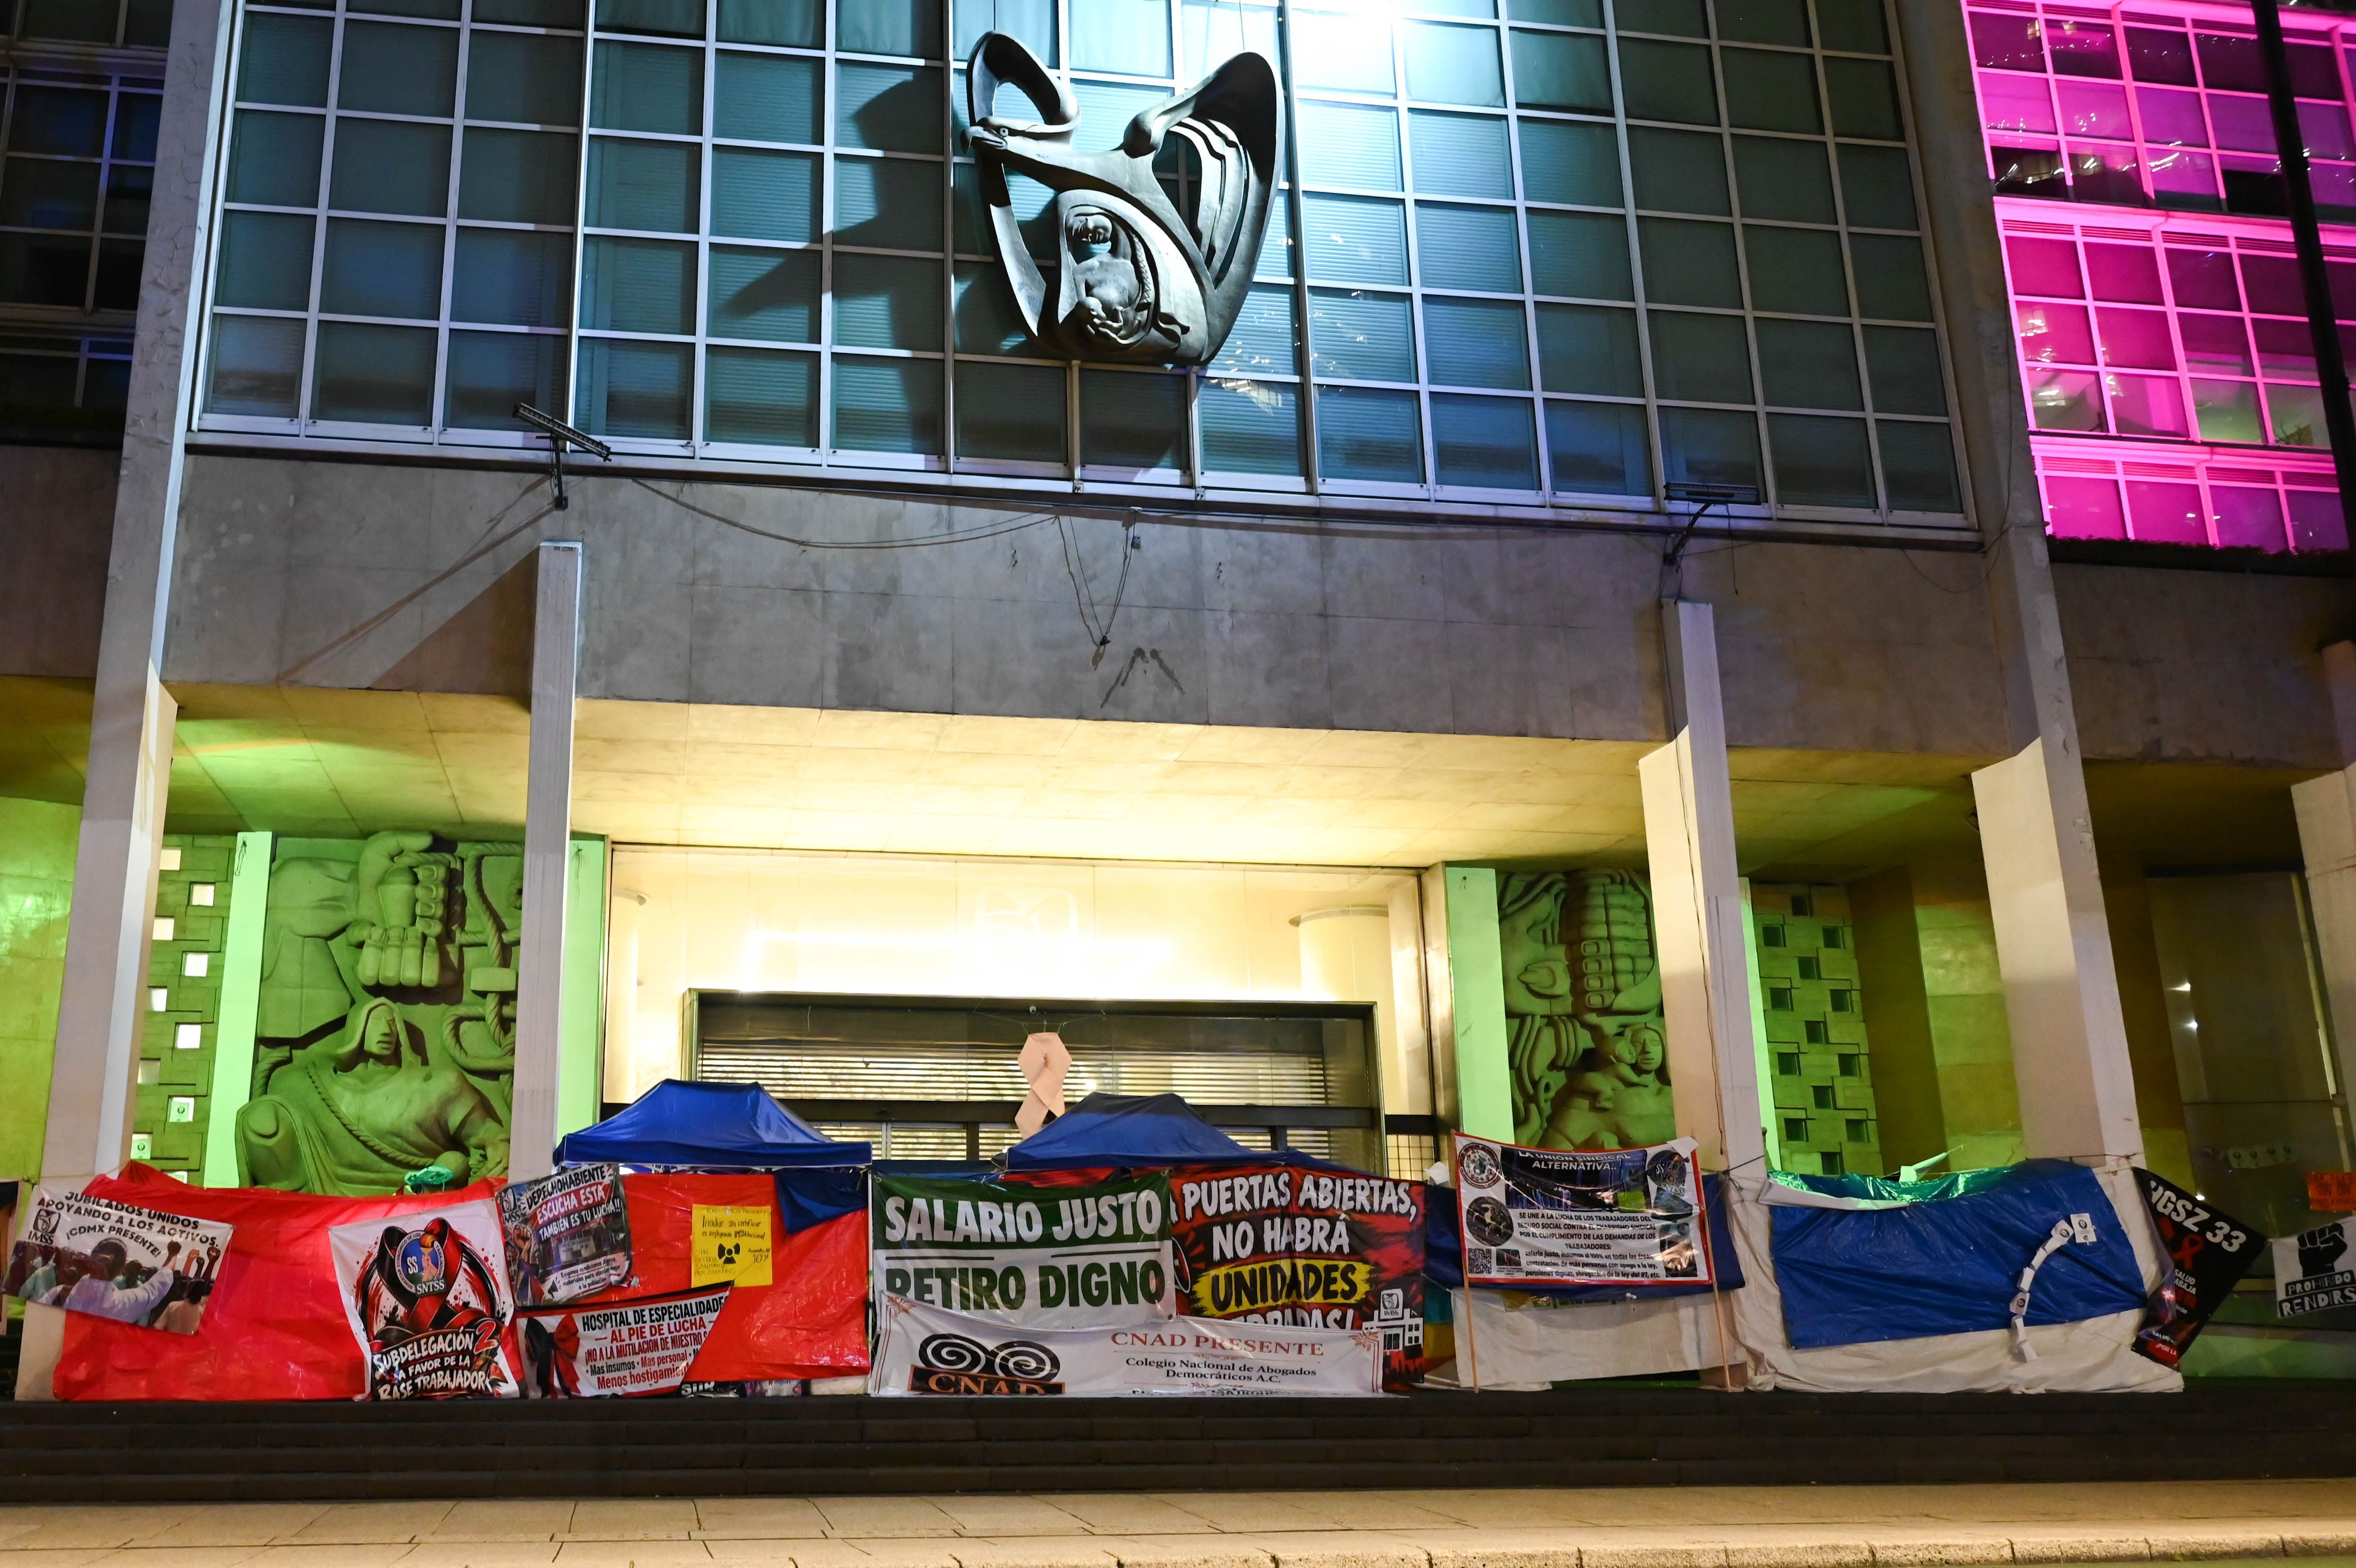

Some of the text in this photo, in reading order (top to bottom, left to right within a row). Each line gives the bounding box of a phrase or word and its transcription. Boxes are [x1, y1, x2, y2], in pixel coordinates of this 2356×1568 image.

[526, 1165, 606, 1210] DERECHOHABIENTE
[1183, 1172, 1291, 1221] PUERTAS
[1298, 1174, 1417, 1223] ABIERTAS,
[1660, 1182, 1685, 1196] SNTSS
[65, 1191, 199, 1230] JUBILADOS UNIDOS
[536, 1184, 605, 1225] ESCUCHA ESTA
[886, 1196, 1043, 1243] SALARIO
[1052, 1189, 1162, 1240] JUSTO
[37, 1197, 219, 1247] APOYANDO A LOS ACTIVOS.
[539, 1214, 569, 1241] TAMBIÉN
[571, 1213, 580, 1226] ES
[581, 1210, 592, 1222] TU
[2206, 1221, 2247, 1252] 33
[28, 1231, 54, 1245] IMSS
[108, 1225, 162, 1257] PRESENTE!
[1213, 1212, 1350, 1262] NO HABRÁ
[406, 1256, 419, 1274] SS
[1525, 1269, 1554, 1277] pensiones
[2174, 1269, 2196, 1285] SALUD
[416, 1279, 445, 1295] SNTSS
[886, 1260, 1165, 1310] RETIRO DIGNO
[1211, 1262, 1358, 1313] UNIDADES
[582, 1296, 728, 1332] HOSPITAL DE ESPECIALIDADE
[611, 1329, 626, 1344] AL
[628, 1326, 647, 1341] PIE
[649, 1323, 665, 1338] DE
[667, 1316, 707, 1335] LUCHA
[1111, 1332, 1324, 1356] CNAD PRESENTE
[373, 1320, 499, 1372] SUBDELEGACIÓN 2
[599, 1347, 604, 1361] A
[605, 1345, 615, 1360] LA
[616, 1338, 659, 1359] MUTILACION
[660, 1336, 670, 1351] DE
[670, 1332, 702, 1350] NUESTRO
[398, 1355, 470, 1381] A FAVOR DE LA
[590, 1364, 605, 1376] Mas
[605, 1360, 635, 1374] insumos
[641, 1356, 656, 1368] Mas
[657, 1349, 688, 1368] personal
[1126, 1357, 1317, 1377] Colegio Nacional de Abogados
[1165, 1369, 1281, 1384] Democráticos A.C.
[378, 1379, 414, 1401] BASE
[597, 1375, 628, 1390] Menos
